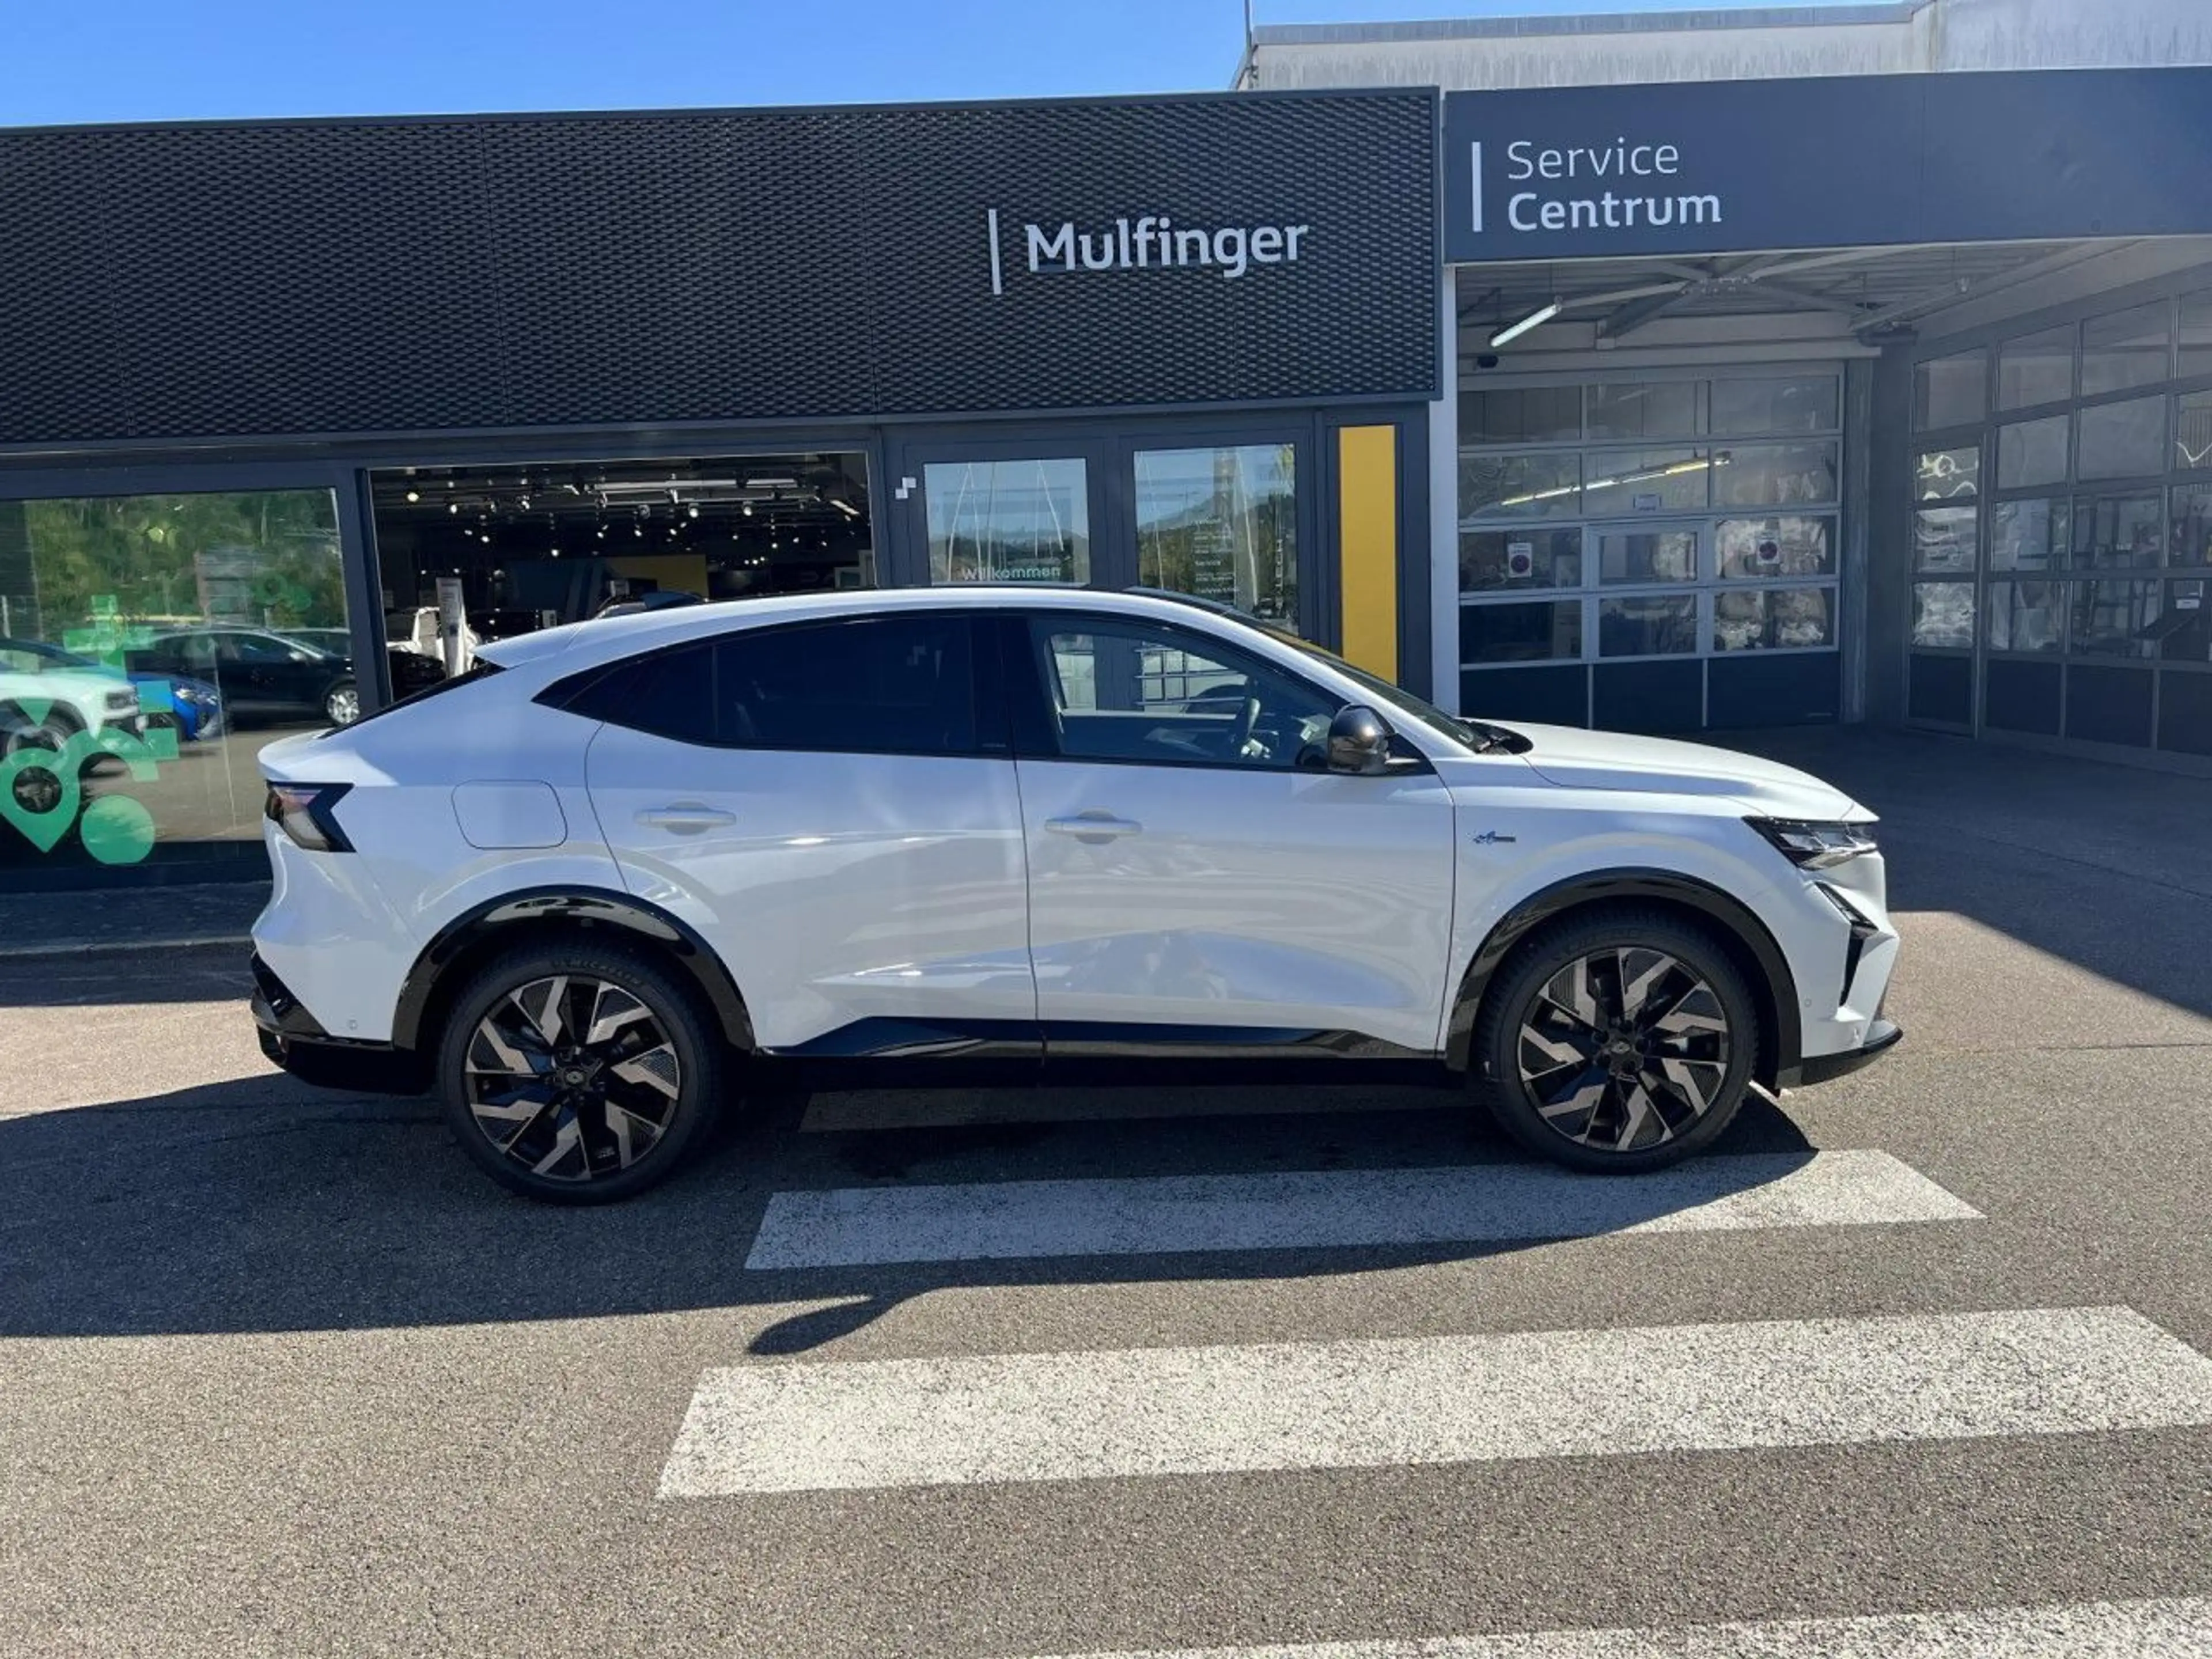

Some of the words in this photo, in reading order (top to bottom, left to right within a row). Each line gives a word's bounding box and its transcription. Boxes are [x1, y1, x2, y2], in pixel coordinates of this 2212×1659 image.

[1508, 137, 1679, 179] Service
[1508, 192, 1722, 231] Centrum
[1025, 217, 1309, 278] Mulfinger
